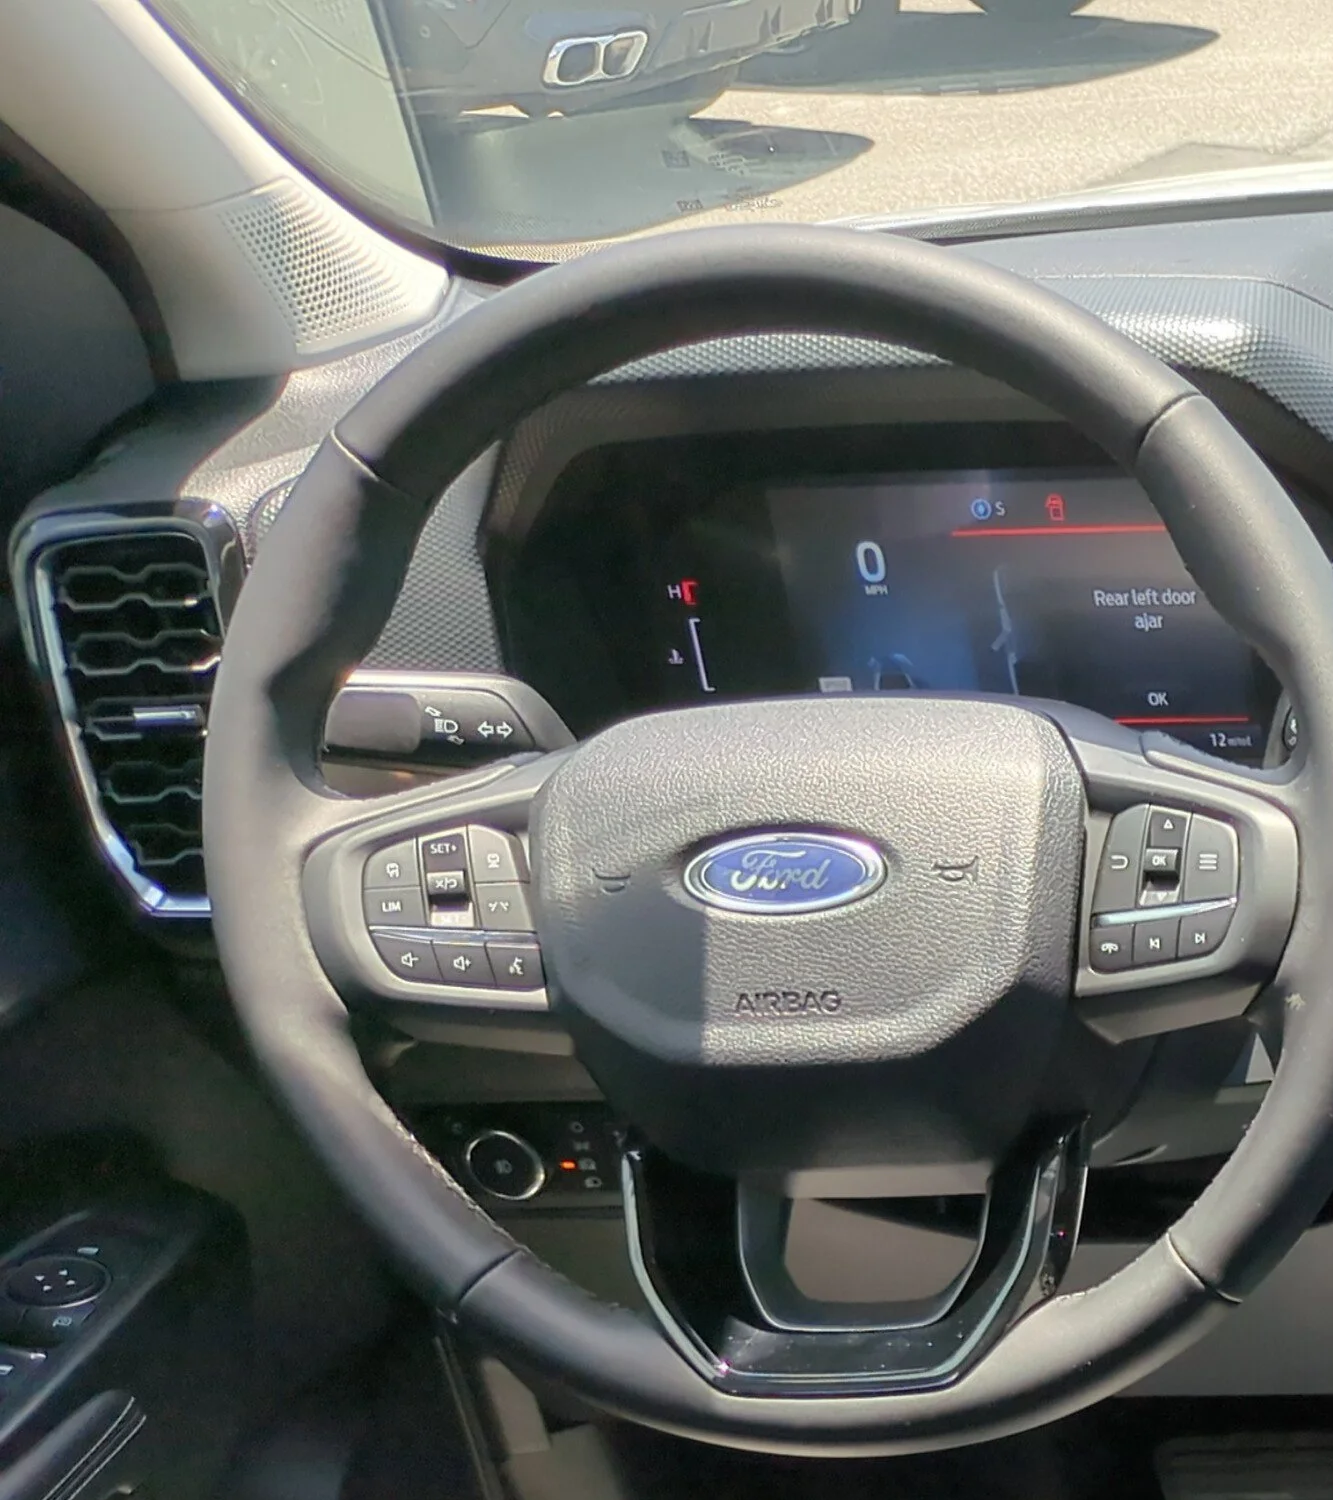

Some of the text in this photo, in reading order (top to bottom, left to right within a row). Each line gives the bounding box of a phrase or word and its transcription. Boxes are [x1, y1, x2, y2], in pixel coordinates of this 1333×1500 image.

[855, 541, 887, 583] 0
[666, 585, 681, 599] H
[864, 584, 889, 597] MPH
[1093, 588, 1197, 607] Rear left door
[1134, 614, 1164, 632] ajar
[1147, 692, 1169, 707] OK
[1209, 732, 1227, 748] 12
[1151, 855, 1167, 866] OK
[730, 849, 832, 892] Ford
[381, 902, 402, 913] LIM
[735, 990, 843, 1015] AIRBAG
